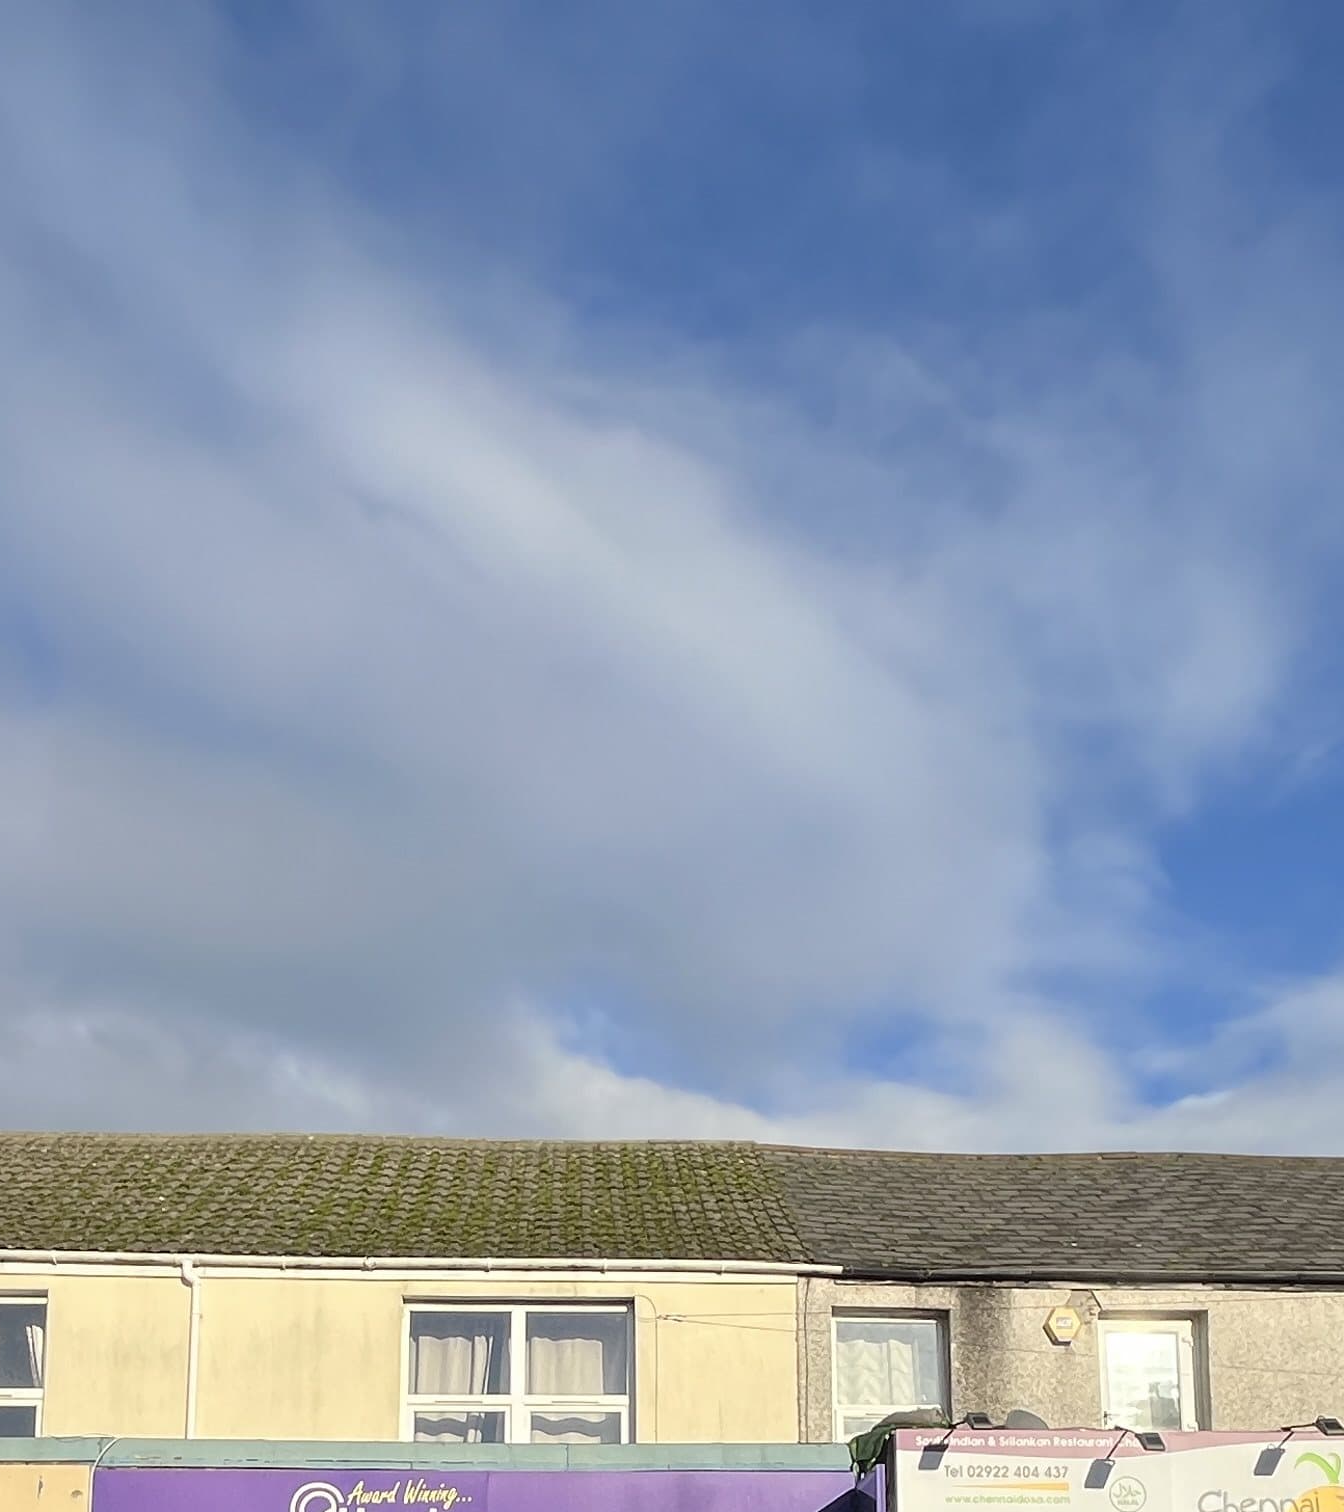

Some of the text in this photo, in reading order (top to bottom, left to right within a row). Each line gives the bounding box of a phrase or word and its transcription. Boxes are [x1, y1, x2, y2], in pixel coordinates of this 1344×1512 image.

[950, 1435, 985, 1446] Indian
[988, 1436, 996, 1446] &
[999, 1436, 1051, 1447] Srilankan
[1053, 1437, 1113, 1447] Restaurant
[944, 1465, 1069, 1478] Tel 02922 404 437
[346, 1480, 400, 1506] Award
